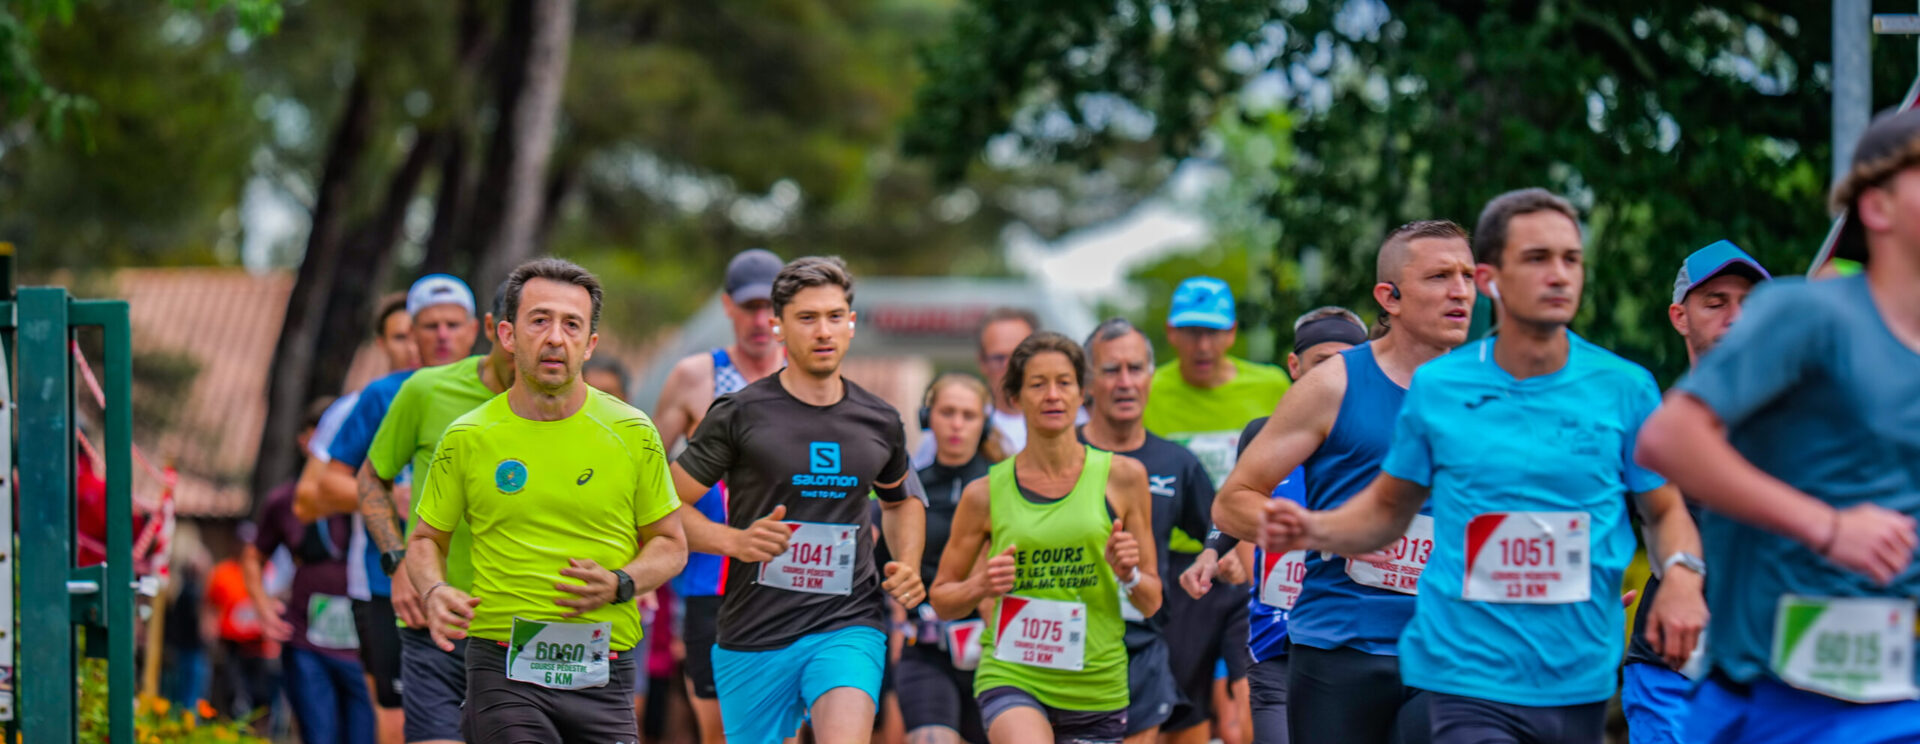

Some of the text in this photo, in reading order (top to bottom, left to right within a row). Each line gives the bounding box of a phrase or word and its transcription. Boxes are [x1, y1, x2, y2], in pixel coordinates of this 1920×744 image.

[791, 542, 833, 566] 1041
[1032, 547, 1084, 564] COURS
[1384, 536, 1433, 564] 013
[1499, 538, 1555, 566] 1051
[1028, 566, 1046, 578] LES
[1049, 563, 1096, 577] ENFANTS
[792, 576, 823, 589] 13 KM
[1383, 573, 1398, 587] 13
[1021, 617, 1063, 642] 1075
[535, 641, 585, 663] 6060
[1036, 652, 1053, 663] KM
[530, 662, 555, 671] COURSE
[544, 671, 573, 685] 6 KM
